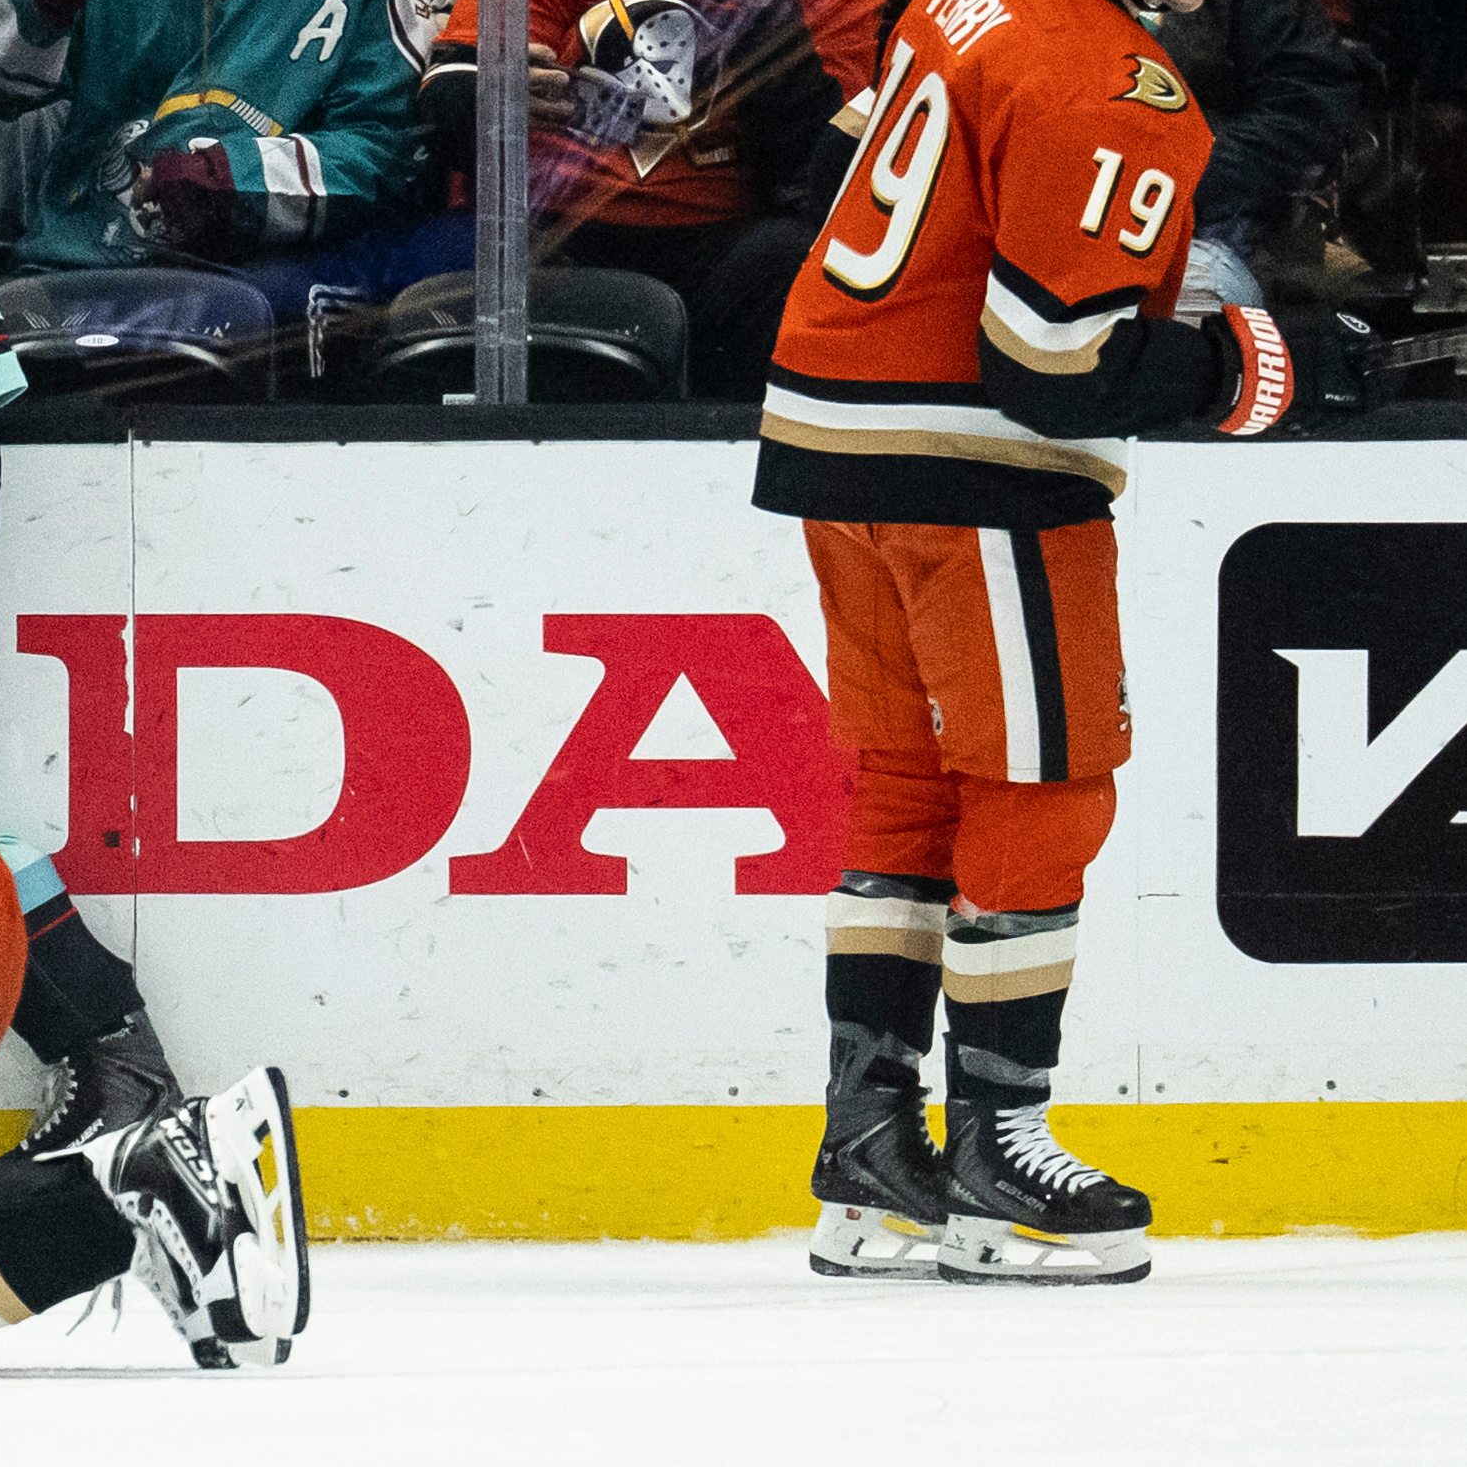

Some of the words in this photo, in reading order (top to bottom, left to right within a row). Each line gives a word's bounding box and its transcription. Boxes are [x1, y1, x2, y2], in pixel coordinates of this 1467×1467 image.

[820, 37, 950, 292] 19
[1078, 145, 1176, 254] 19
[994, 1179, 1048, 1214] BAUER
